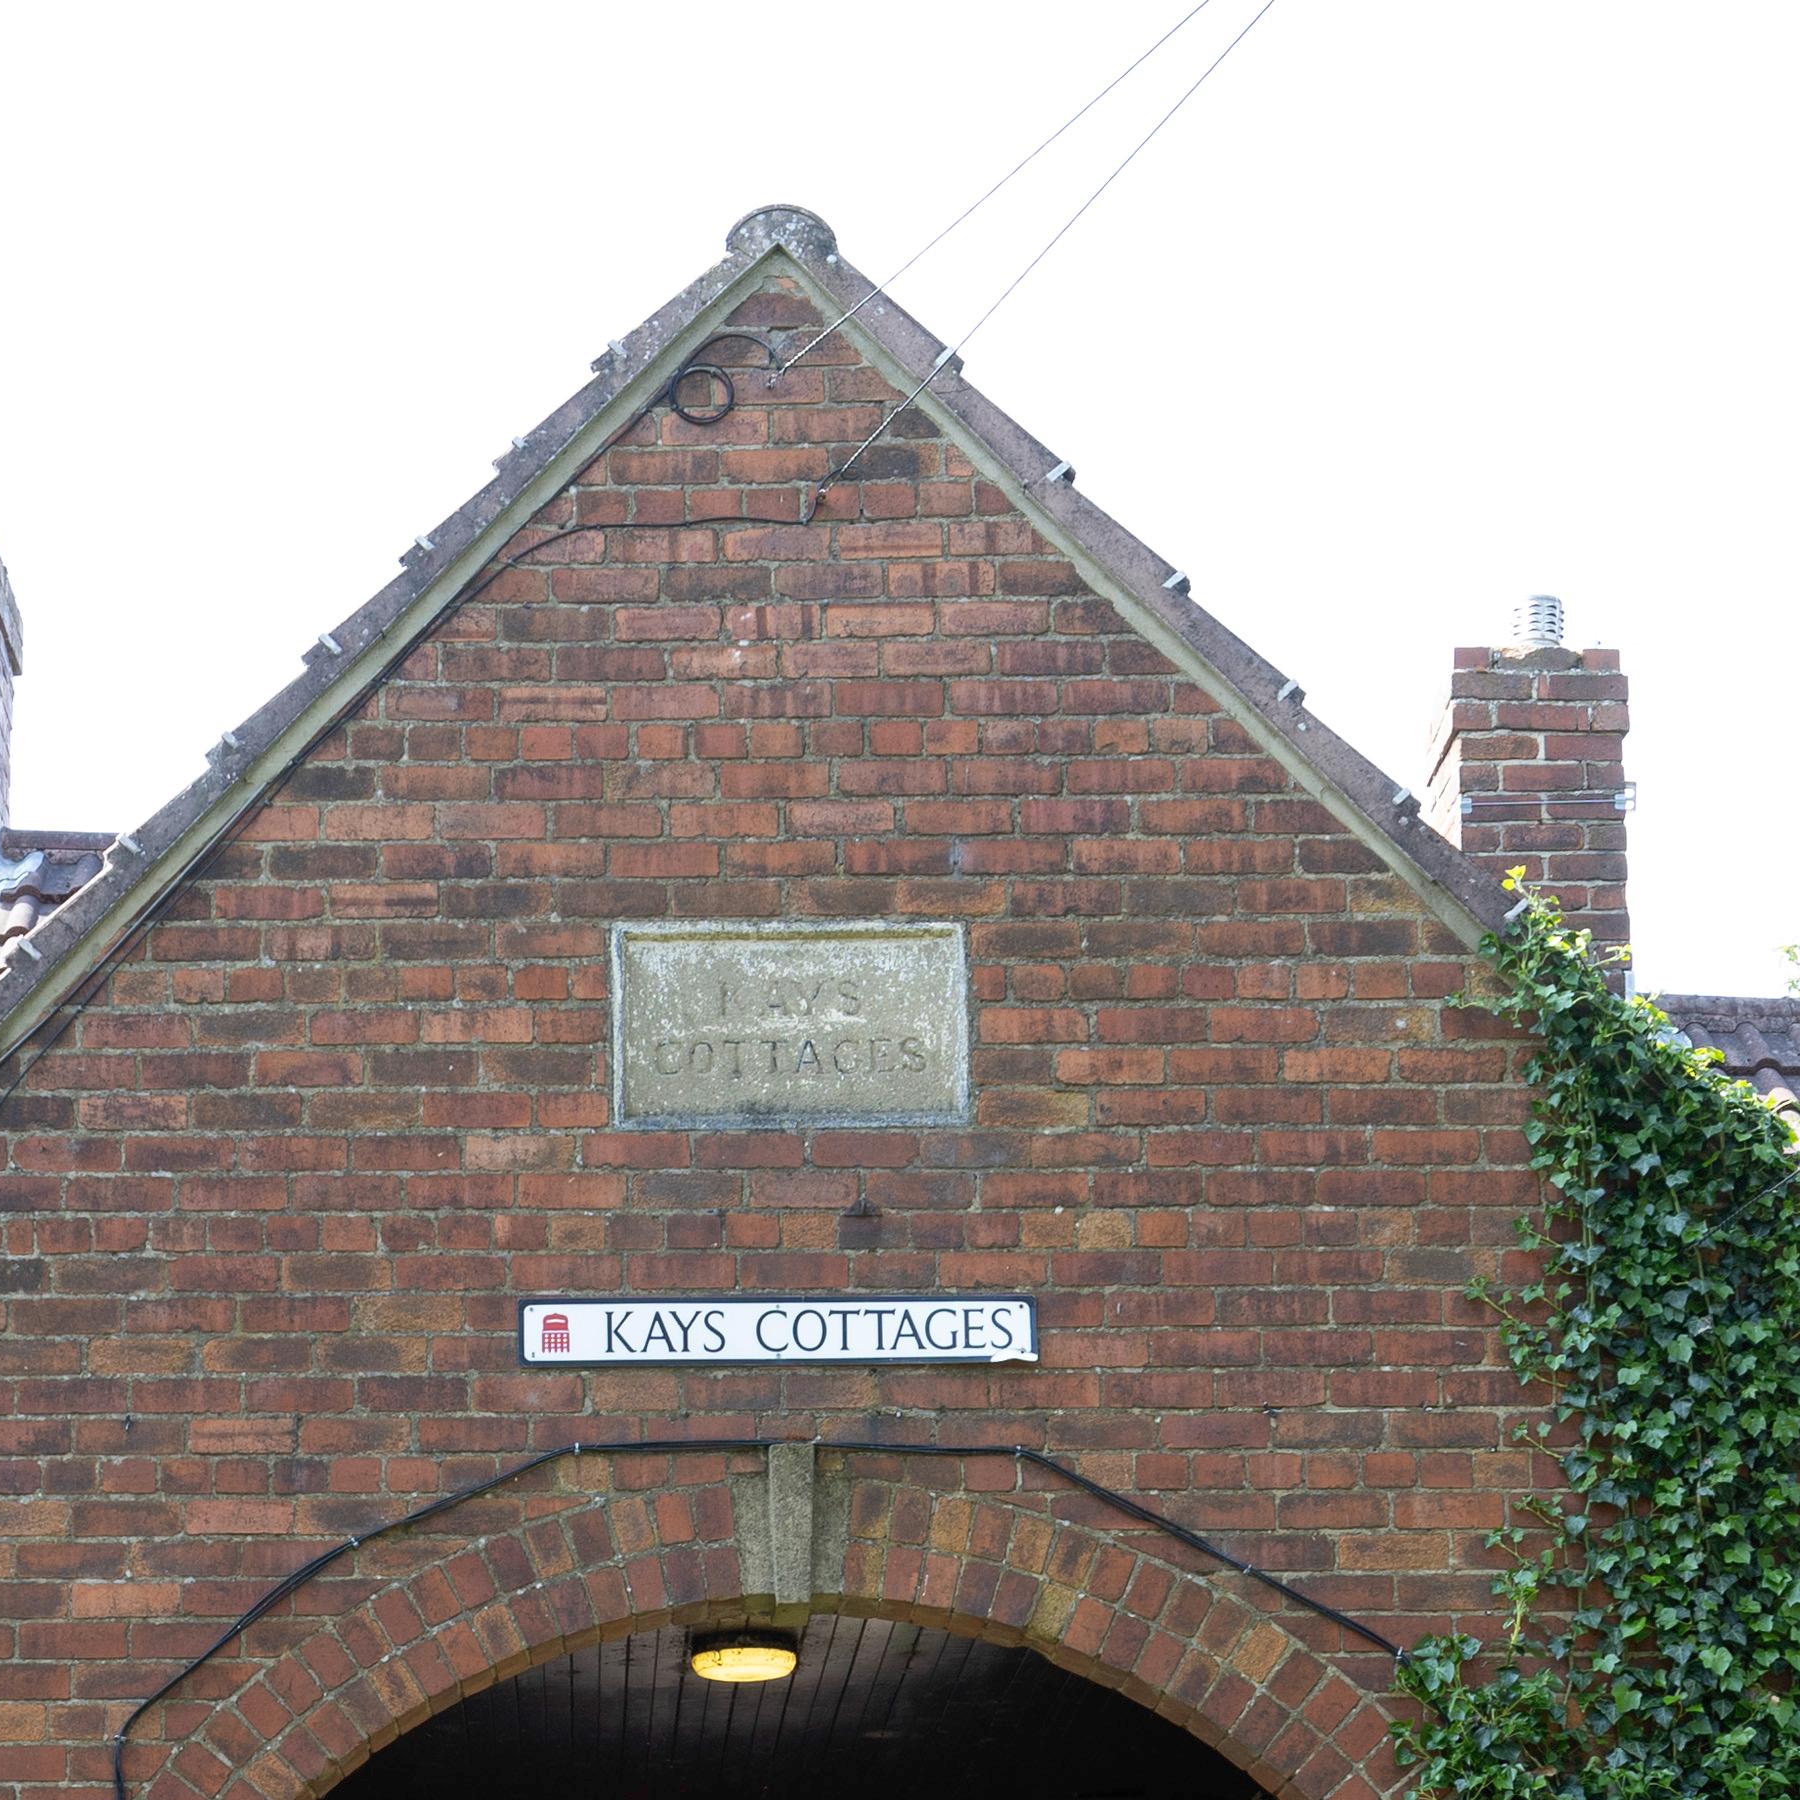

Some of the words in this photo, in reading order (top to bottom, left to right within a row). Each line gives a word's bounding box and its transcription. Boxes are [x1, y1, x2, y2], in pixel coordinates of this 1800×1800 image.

[716, 977, 862, 1017] KAYS
[654, 1036, 928, 1078] COTTAGES
[604, 1308, 727, 1354] KAYS
[755, 1307, 1015, 1353] COTTAGES
